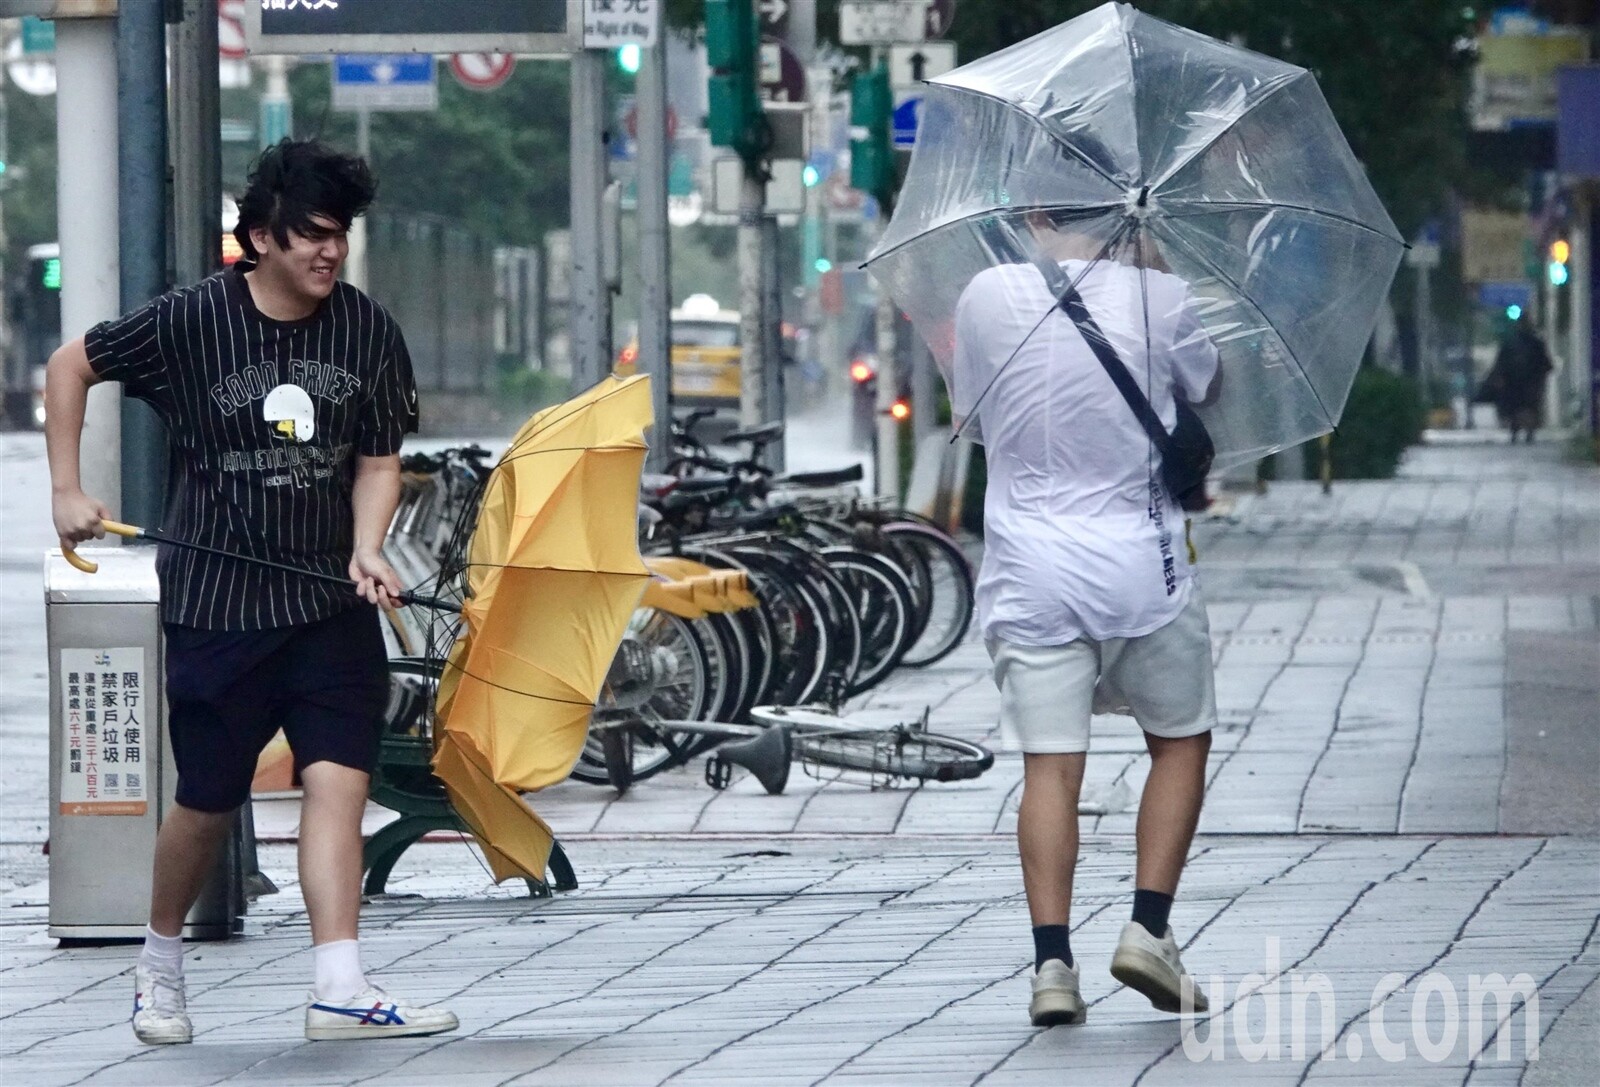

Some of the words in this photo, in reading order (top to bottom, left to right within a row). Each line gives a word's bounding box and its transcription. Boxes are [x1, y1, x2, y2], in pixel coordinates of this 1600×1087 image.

[211, 360, 278, 416] GOOD
[288, 358, 362, 405] GRIEF
[223, 448, 288, 471] ATHLETIC
[102, 672, 119, 763] 禁家戶垃圾
[123, 672, 141, 763] 限行人使用
